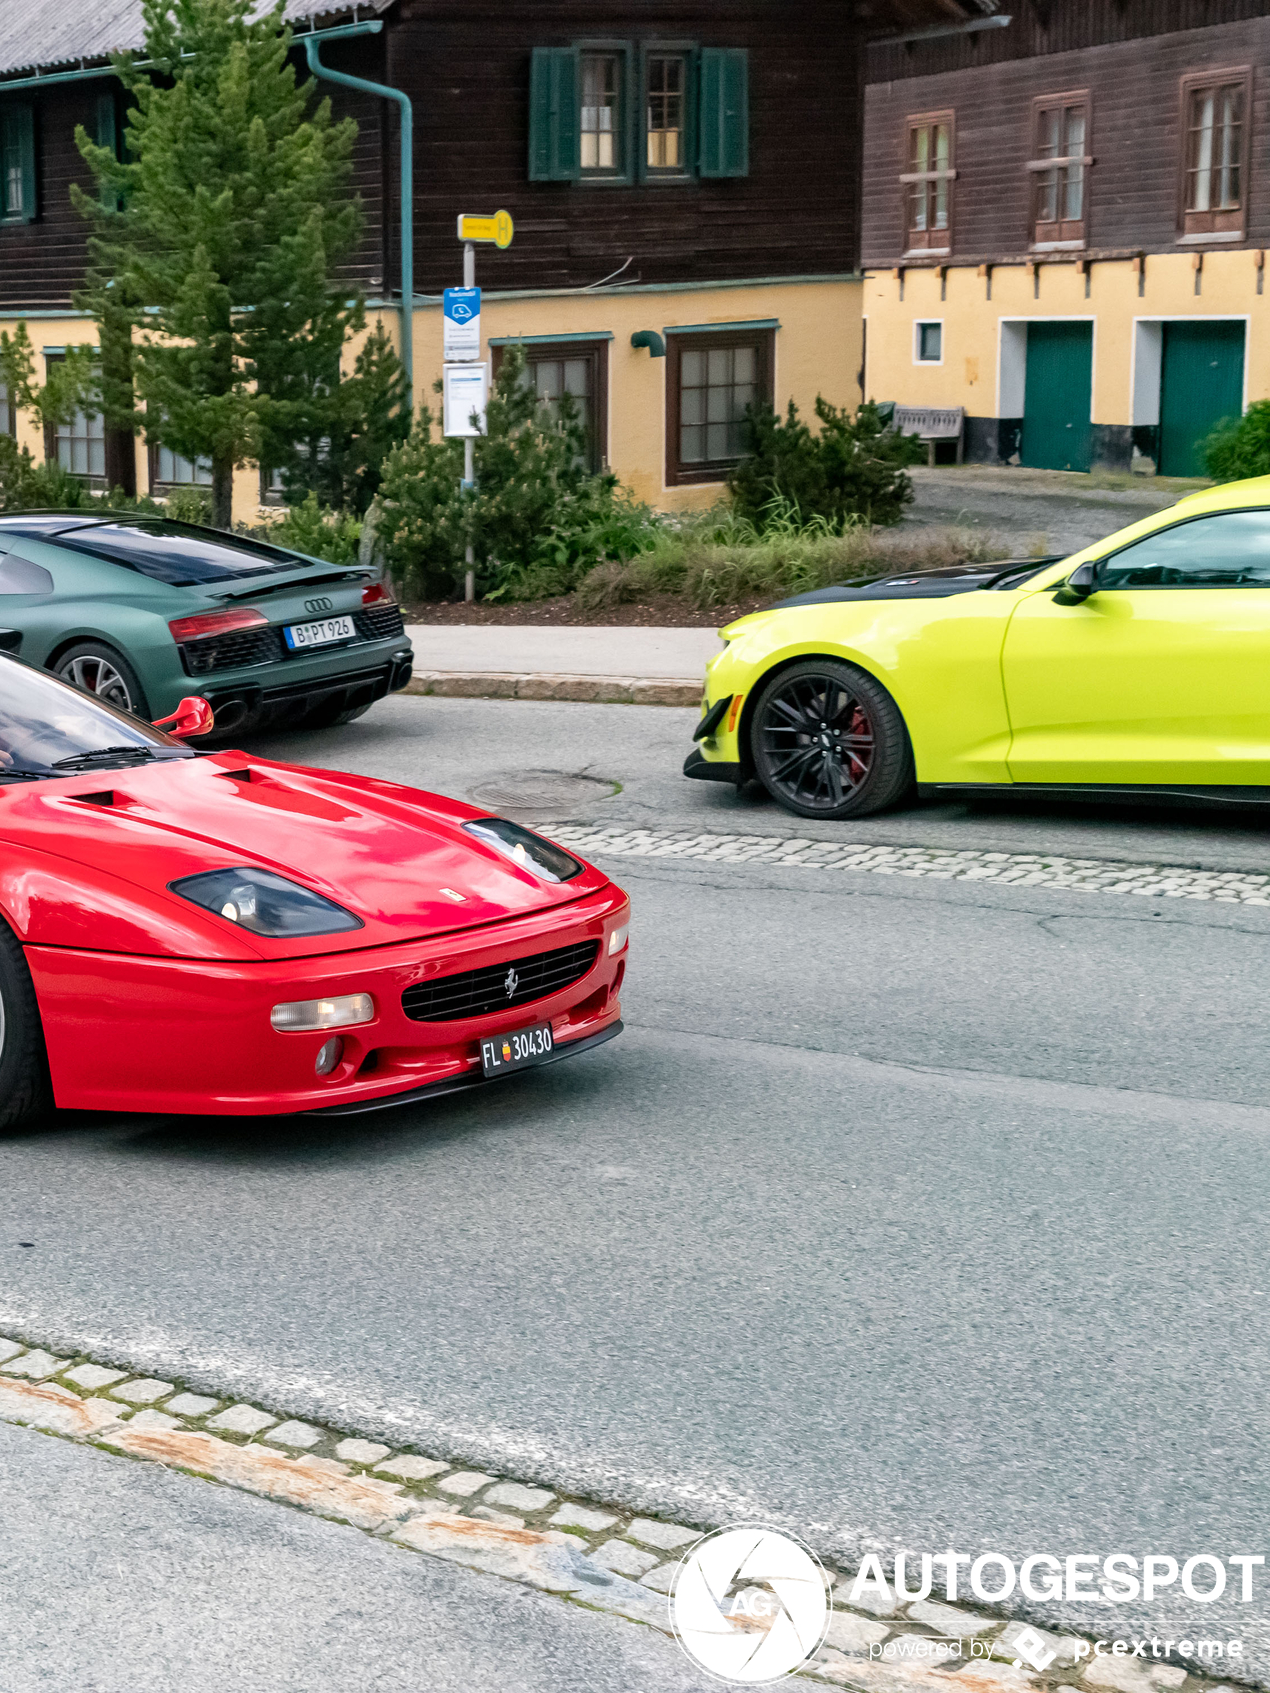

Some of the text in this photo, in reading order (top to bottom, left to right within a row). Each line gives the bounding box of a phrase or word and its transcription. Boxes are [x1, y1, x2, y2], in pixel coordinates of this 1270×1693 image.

[296, 616, 350, 643] B PT 926
[482, 1027, 552, 1069] FL 30430
